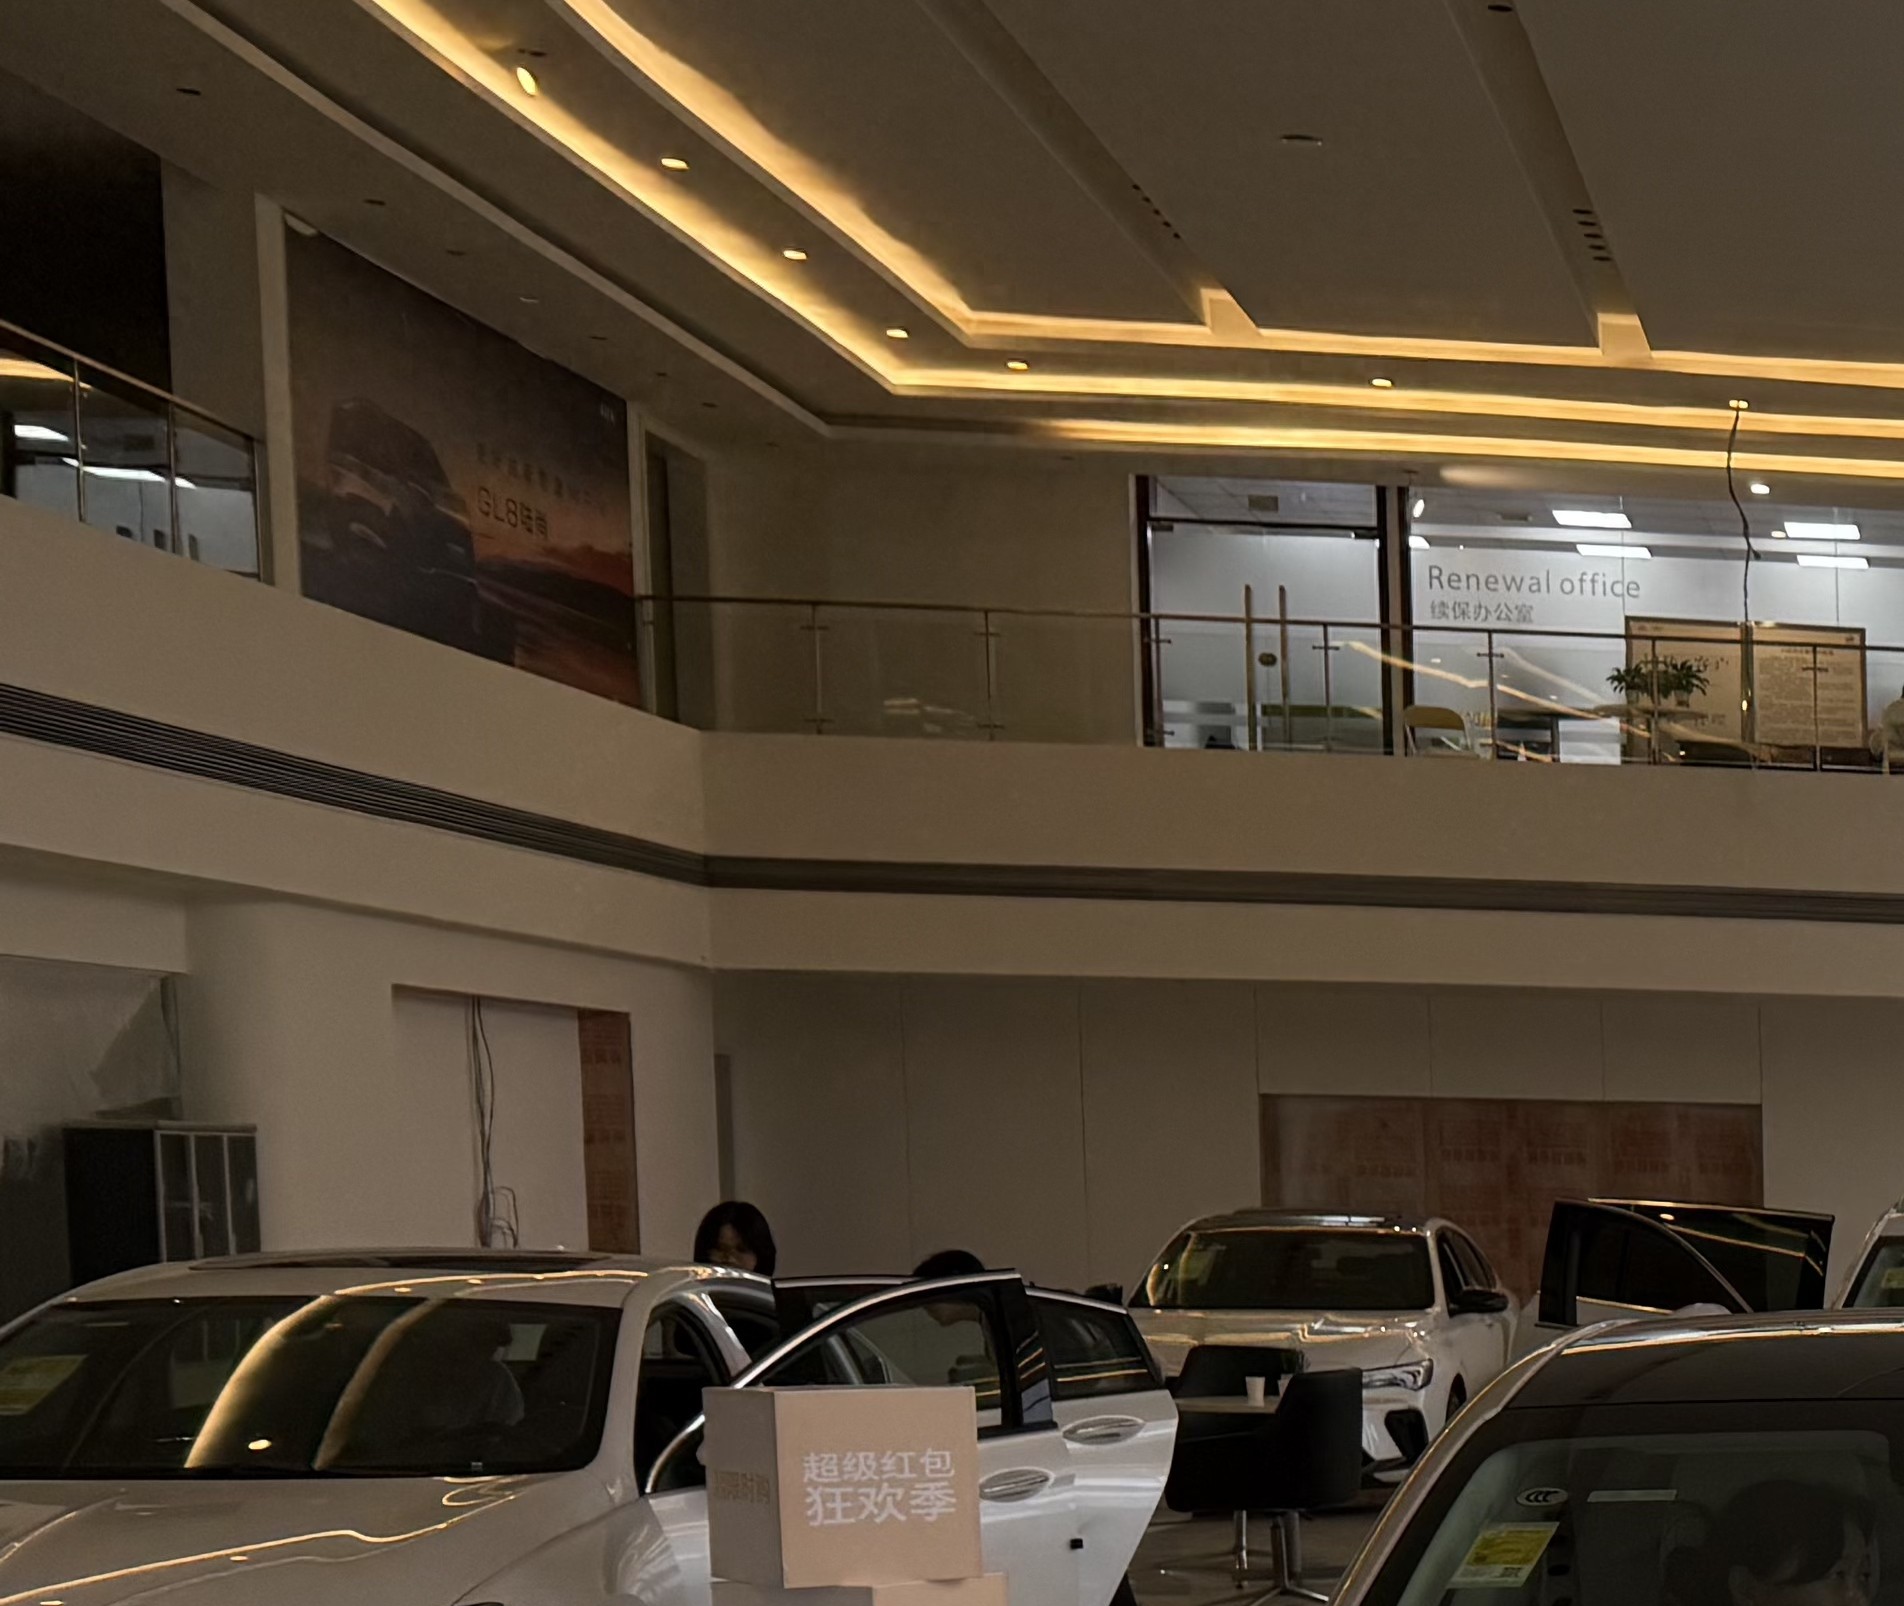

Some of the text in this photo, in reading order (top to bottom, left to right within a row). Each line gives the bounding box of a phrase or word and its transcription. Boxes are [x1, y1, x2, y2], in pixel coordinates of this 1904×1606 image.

[1428, 565, 1642, 599] Renewal office
[1430, 600, 1535, 624] 续保办公室
[802, 1447, 956, 1484] 超级红包
[804, 1482, 957, 1525] 狂欢季
